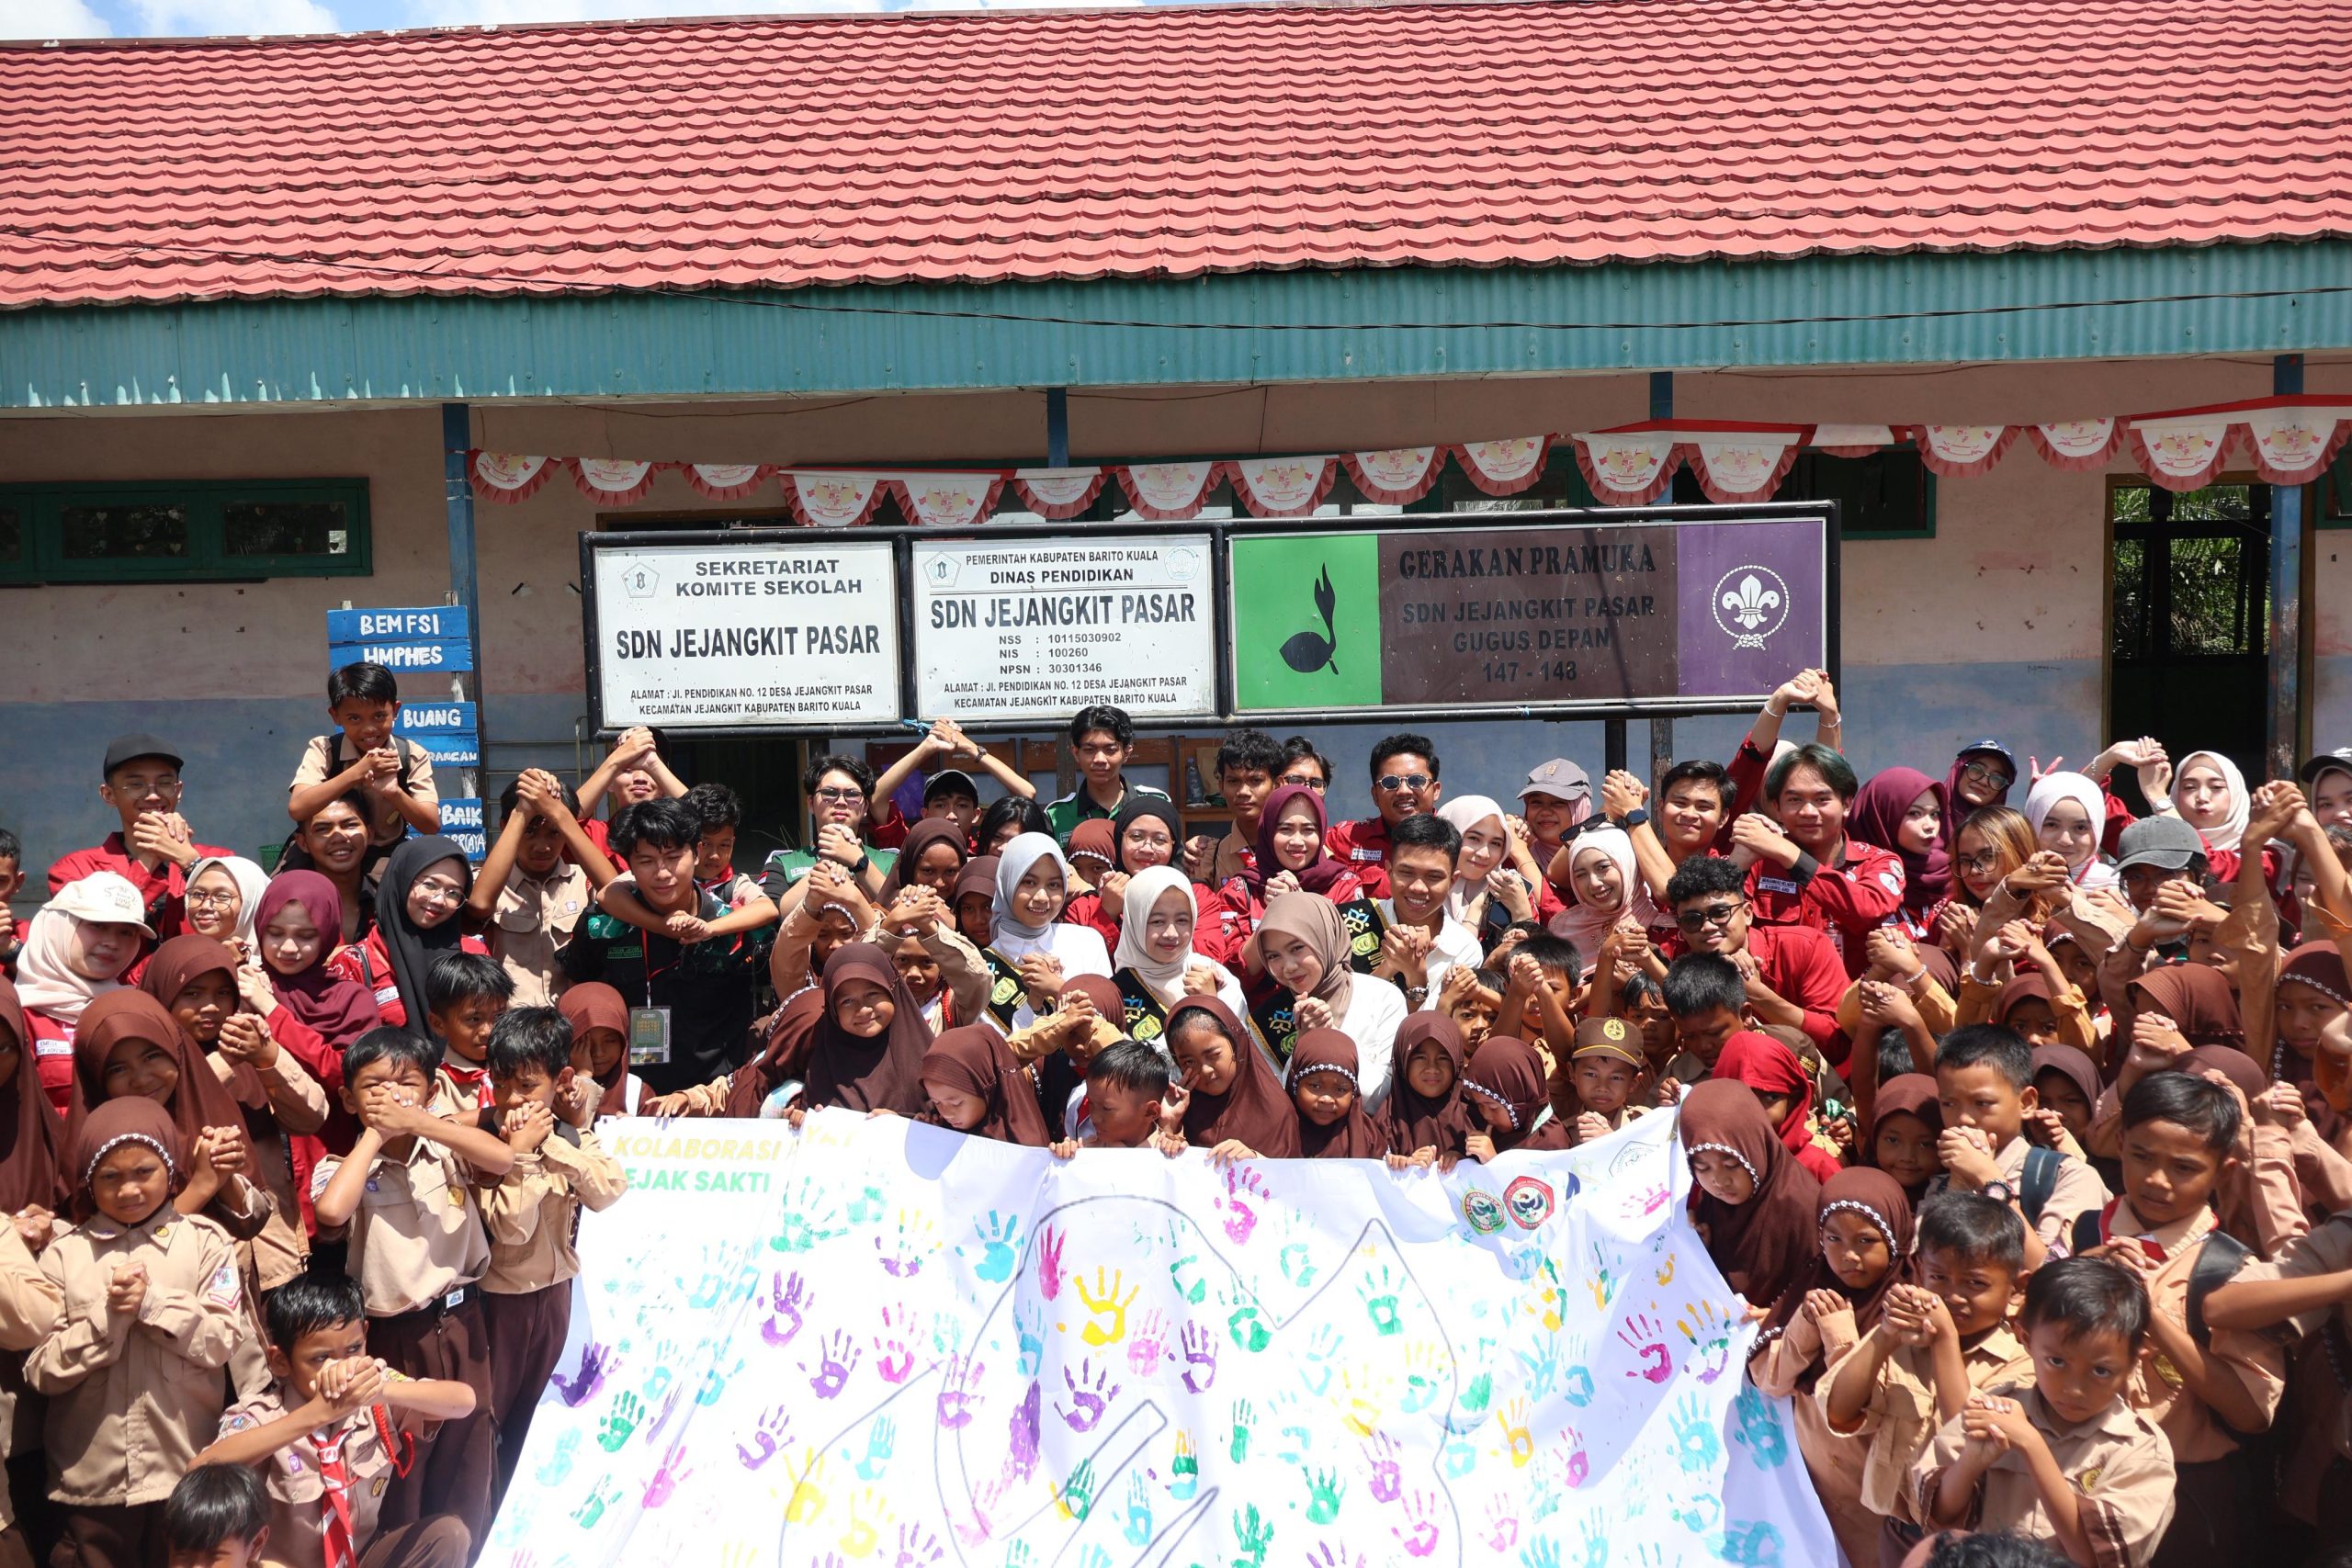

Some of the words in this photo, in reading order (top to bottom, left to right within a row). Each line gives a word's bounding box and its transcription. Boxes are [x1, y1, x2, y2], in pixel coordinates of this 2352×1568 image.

[966, 553, 1027, 566] PEMERINTAH
[1029, 552, 1086, 564] KABUPATEN
[1089, 551, 1124, 562] BARITO
[1126, 550, 1159, 561] KUALA
[1399, 547, 1523, 580] GERAKAN
[1530, 544, 1656, 575] PRAMUKA
[695, 559, 840, 577] SEKRETARIAT
[990, 570, 1035, 584] DINAS
[1041, 568, 1134, 583] PENDIDIKAN
[676, 581, 757, 597] KOMITE
[763, 579, 862, 595] SEKOLAH
[931, 599, 977, 629] SDN
[984, 595, 1114, 628] JEJANGKIT
[1121, 592, 1195, 624] PASAR
[1403, 603, 1446, 624] SDN
[1453, 598, 1577, 622] JEJANGKIT
[1585, 595, 1655, 618] PASAR
[360, 615, 402, 636] BEM
[406, 614, 439, 635] FSI
[616, 628, 662, 660] SDN
[670, 626, 798, 659] JEJANGKIT
[807, 625, 880, 655] PASAR
[1000, 635, 1022, 645] NSS
[1453, 630, 1530, 653] GUGUS
[1538, 627, 1611, 649] DEPAN
[364, 646, 443, 666] HMPHES
[1000, 649, 1019, 659] NIS
[1048, 648, 1089, 658] 100260
[1000, 664, 1031, 674] NPSN
[1048, 662, 1102, 673] 30301346
[1484, 662, 1520, 682] 147
[1541, 660, 1577, 682] 148
[631, 689, 665, 700] ALAMAT
[684, 687, 738, 699] PENDIDIKAN
[740, 687, 755, 697] NO.
[757, 687, 767, 697] 12
[769, 686, 792, 696] DESA
[794, 685, 842, 696] JEJANGKIT
[844, 684, 873, 695] PASAR
[944, 682, 978, 693] ALAMAT
[999, 681, 1051, 692] PENDIDIKAN
[1054, 681, 1069, 690] NO.
[1071, 680, 1081, 690] 12
[1083, 679, 1106, 690] DESA
[1108, 678, 1157, 689] JEJANGKIT
[1159, 677, 1187, 687] PASAR
[639, 704, 692, 715] KECAMATAN
[694, 703, 742, 714] JEJANGKIT
[744, 701, 796, 714] KABUPATEN
[797, 701, 830, 712] BARITO
[831, 701, 861, 711] KUALA
[954, 697, 1007, 708] KECAMATAN
[1009, 695, 1057, 707] JEJANGKIT
[1059, 694, 1112, 705] KABUPATEN
[1114, 694, 1146, 705] BARITO
[1148, 694, 1177, 704] KUALA
[403, 709, 461, 728] BUANG
[429, 751, 477, 762] RANGAN
[438, 804, 482, 827] BAIK
[613, 1135, 782, 1161] KOLABORASI
[625, 1168, 689, 1191] EJAK
[694, 1170, 771, 1193] SAKTI
